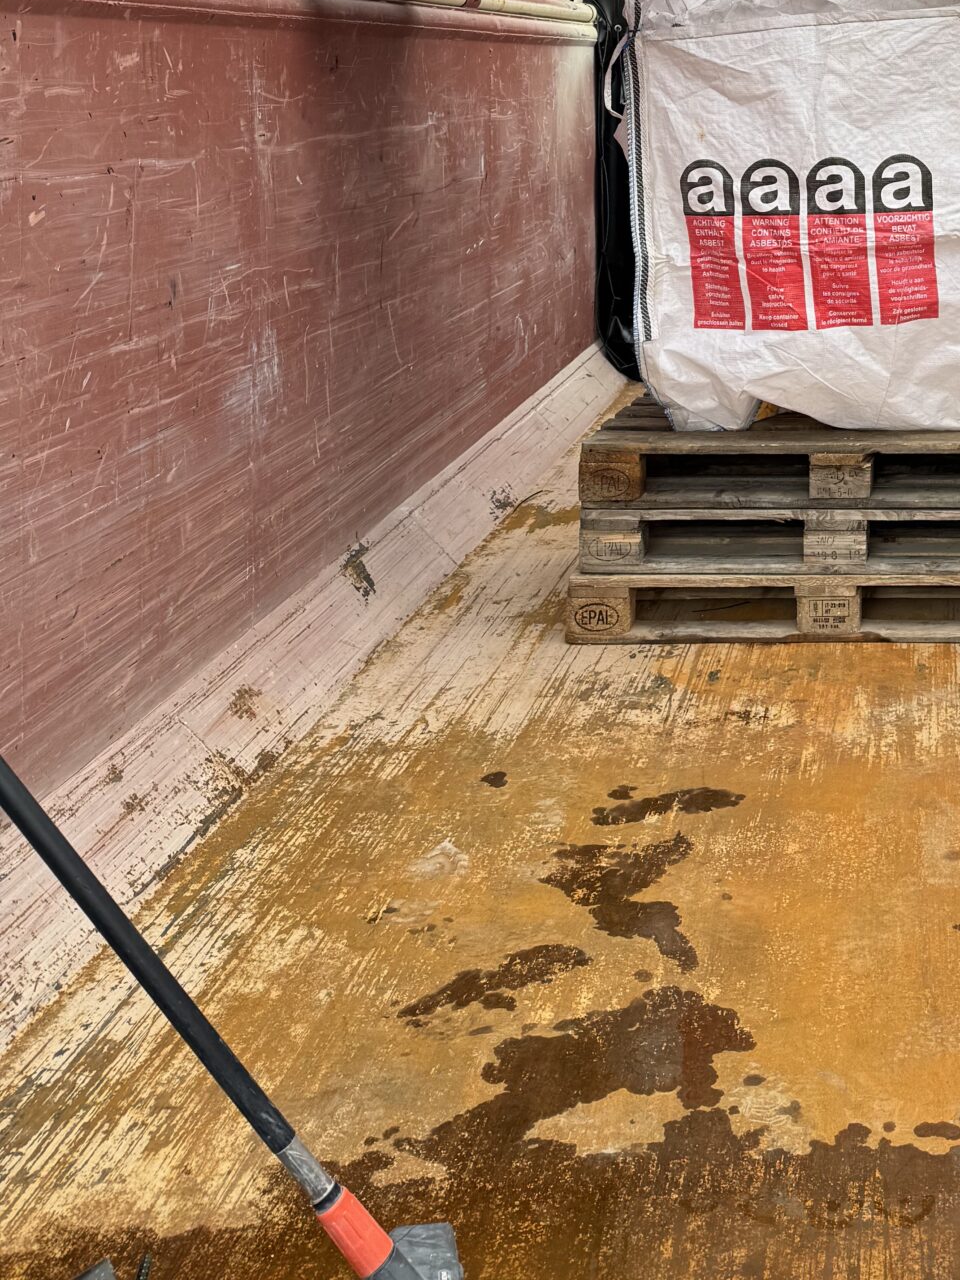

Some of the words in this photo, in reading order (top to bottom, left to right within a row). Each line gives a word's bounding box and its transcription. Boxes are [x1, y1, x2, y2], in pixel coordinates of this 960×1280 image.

[687, 167, 726, 212] a
[748, 167, 791, 212] a
[815, 165, 858, 211] a
[881, 162, 925, 209] a
[693, 218, 725, 228] ACHTUNG
[752, 218, 789, 227] WARNING
[876, 213, 931, 223] VOORZICHTIG
[751, 229, 791, 237] CONTAINS
[891, 224, 917, 233] BEVAT
[699, 239, 724, 247] ASBEST
[889, 234, 920, 242] ASBEST
[750, 239, 793, 248] ASBESTOS
[580, 609, 611, 625] EPAL
